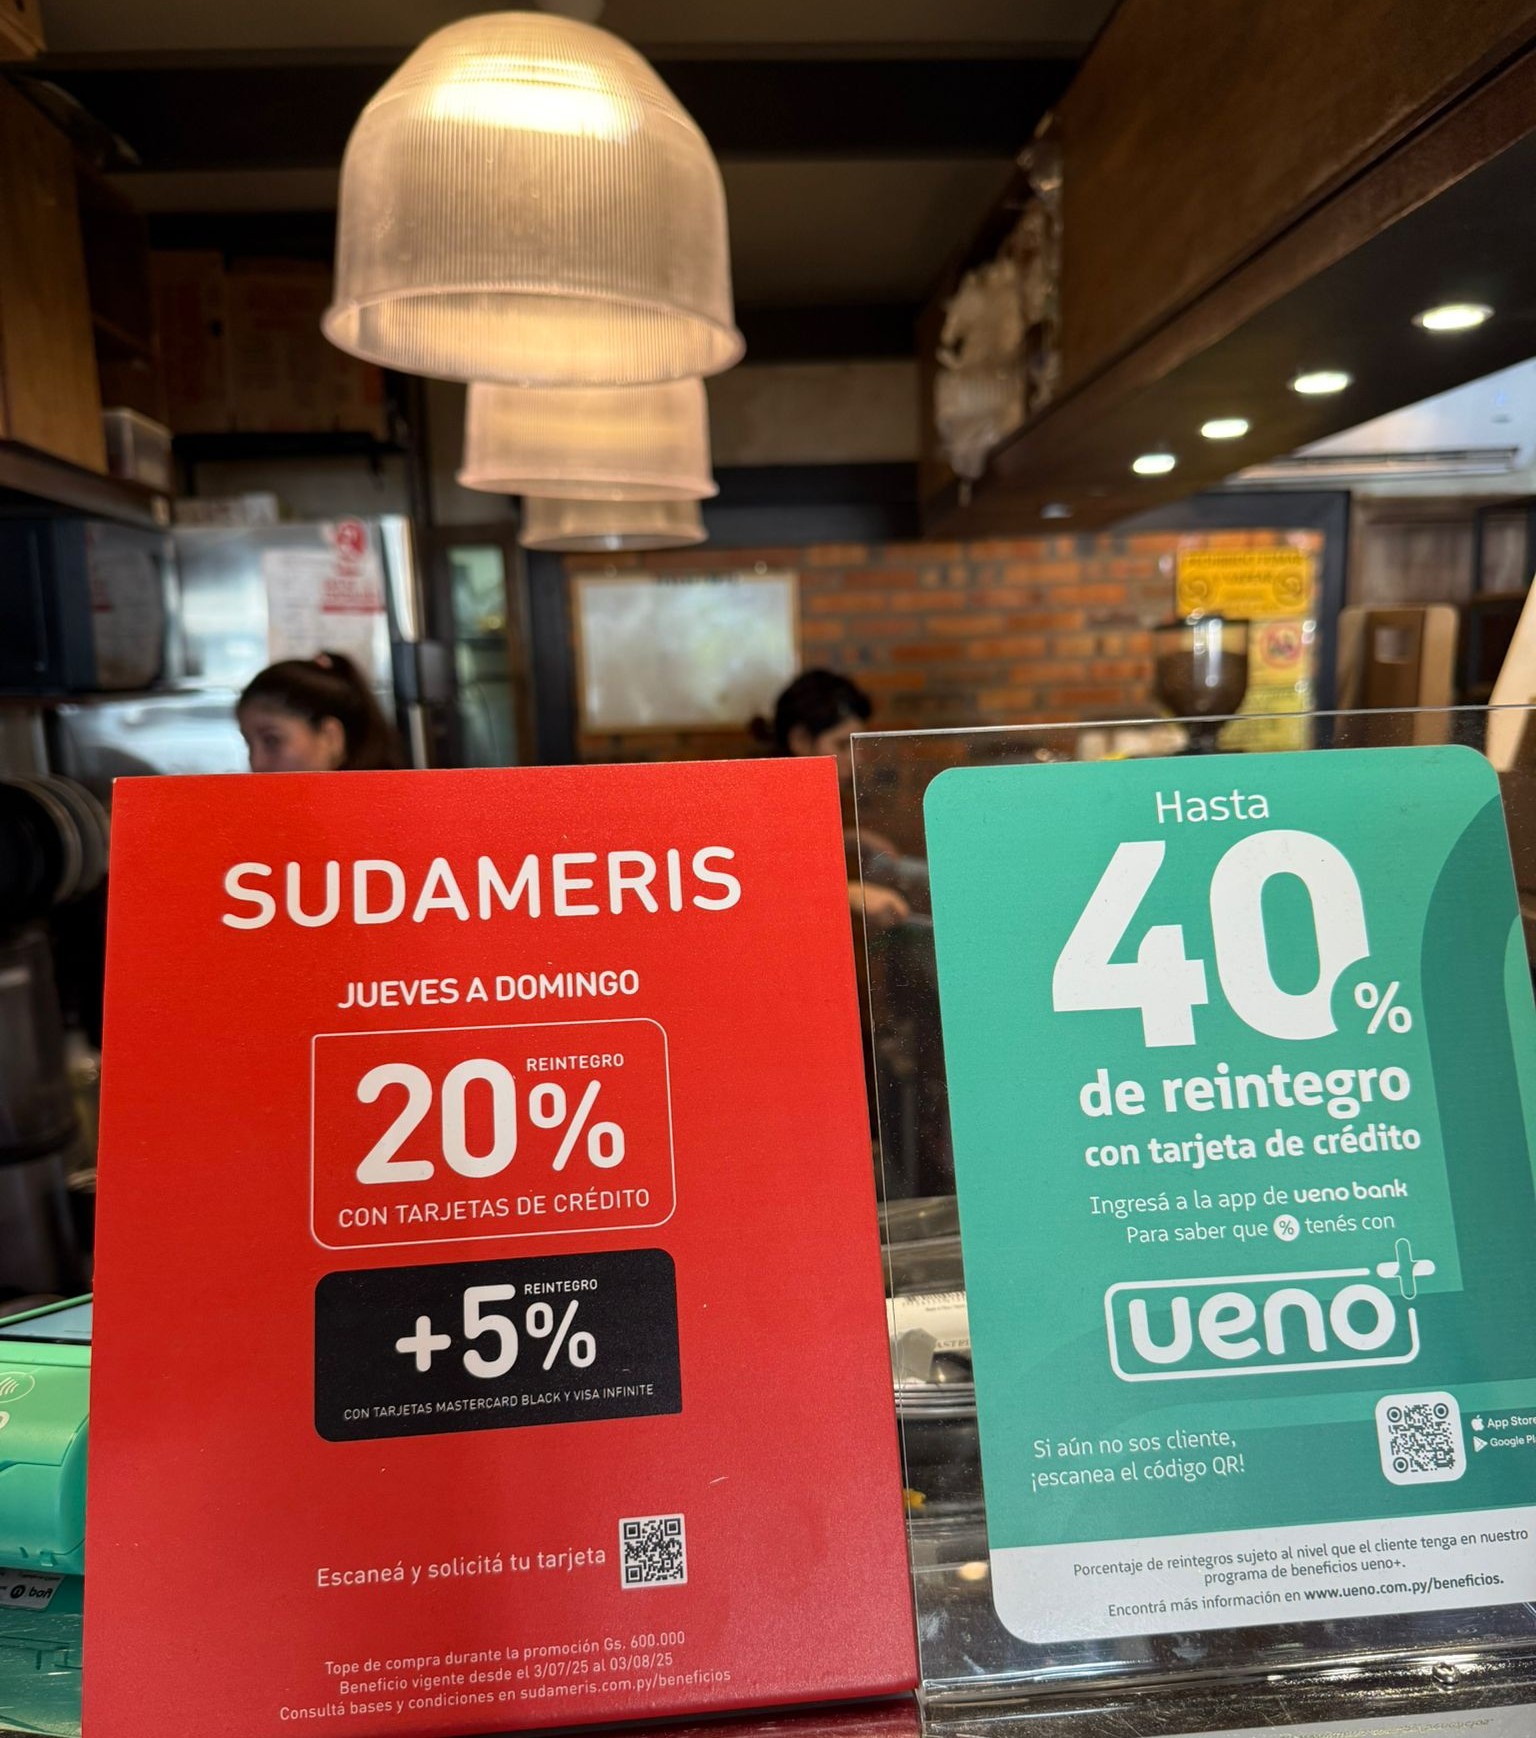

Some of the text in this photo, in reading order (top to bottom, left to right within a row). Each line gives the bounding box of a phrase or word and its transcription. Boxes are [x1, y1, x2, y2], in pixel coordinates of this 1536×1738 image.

[1156, 790, 1269, 823] Hasta
[223, 846, 741, 929] SUDAMERIS
[338, 970, 639, 1008] JUEVES A DOMINGO
[527, 1054, 623, 1071] REINTEGRO
[1080, 1063, 1410, 1119] de reintegro
[357, 1059, 625, 1184] 20%
[1085, 1123, 1420, 1169] con tarjeta de crédito
[339, 1187, 649, 1227] CON TARJETAS DE CRÉDITO
[1090, 1179, 1407, 1219] Ingresá a la app de ueno bank
[1127, 1227, 1168, 1243] Para
[1174, 1222, 1225, 1241] saber
[1233, 1224, 1268, 1242] que
[1305, 1215, 1357, 1233] tenés
[1362, 1216, 1395, 1230] con
[525, 1279, 597, 1294] REINTEGRO
[344, 1384, 653, 1420] CON TARJETAS MASTERCARD BLACK Y VISA INFINITE
[1487, 1418, 1509, 1429] App
[1490, 1435, 1536, 1447] Google Pl
[1034, 1430, 1235, 1458] Si aún no sos cliente,
[1032, 1454, 1244, 1492] ¡escanea el código QR!
[318, 1548, 605, 1587] Escaneá y solicitá tu tarjeta
[1074, 1530, 1528, 1576] Porcentaje de reintegros sujeto al nivel que el cliente tenga en nuestro
[1205, 1559, 1405, 1586] programa de beneficios ueno+.
[1109, 1574, 1504, 1616] Encontrá más información en www.ueno.com.py/beneficios.
[325, 1661, 359, 1676] Tope
[364, 1659, 381, 1672] de
[386, 1656, 440, 1670] compra
[445, 1650, 501, 1664] durante
[507, 1647, 519, 1659] la
[524, 1639, 599, 1661] promoción
[631, 1631, 685, 1648] 600.000
[340, 1652, 672, 1694] Beneficio vigente desde el 3/07/25 al 03/08/25
[280, 1668, 731, 1720] Consultá bases y condiciones en sudameris.com.py/beneficios
